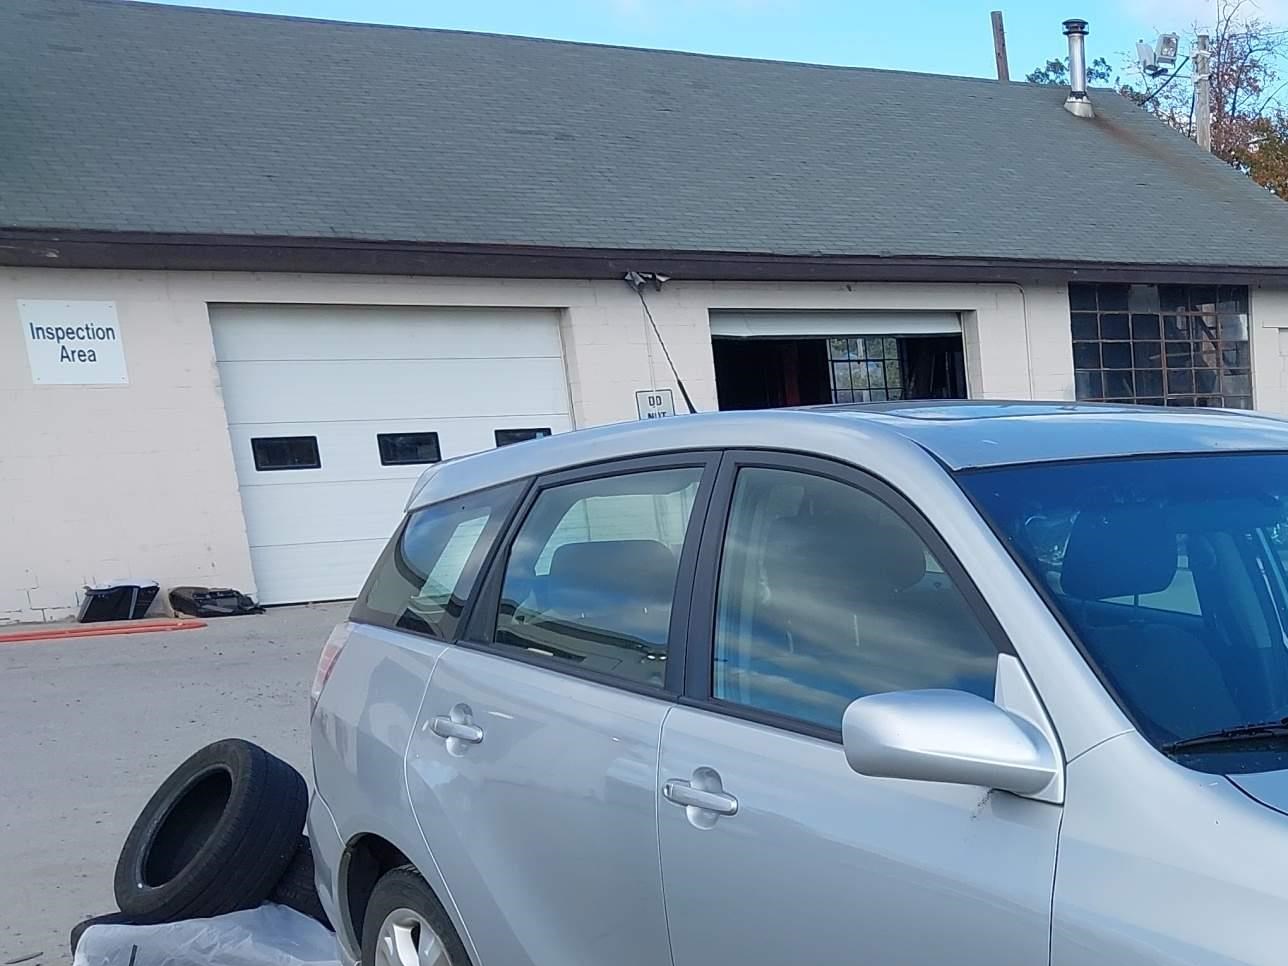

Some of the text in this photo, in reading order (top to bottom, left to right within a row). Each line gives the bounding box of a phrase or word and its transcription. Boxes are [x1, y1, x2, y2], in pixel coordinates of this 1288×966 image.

[29, 322, 116, 344] Inspection
[60, 345, 97, 362] Area
[648, 395, 662, 406] DO
